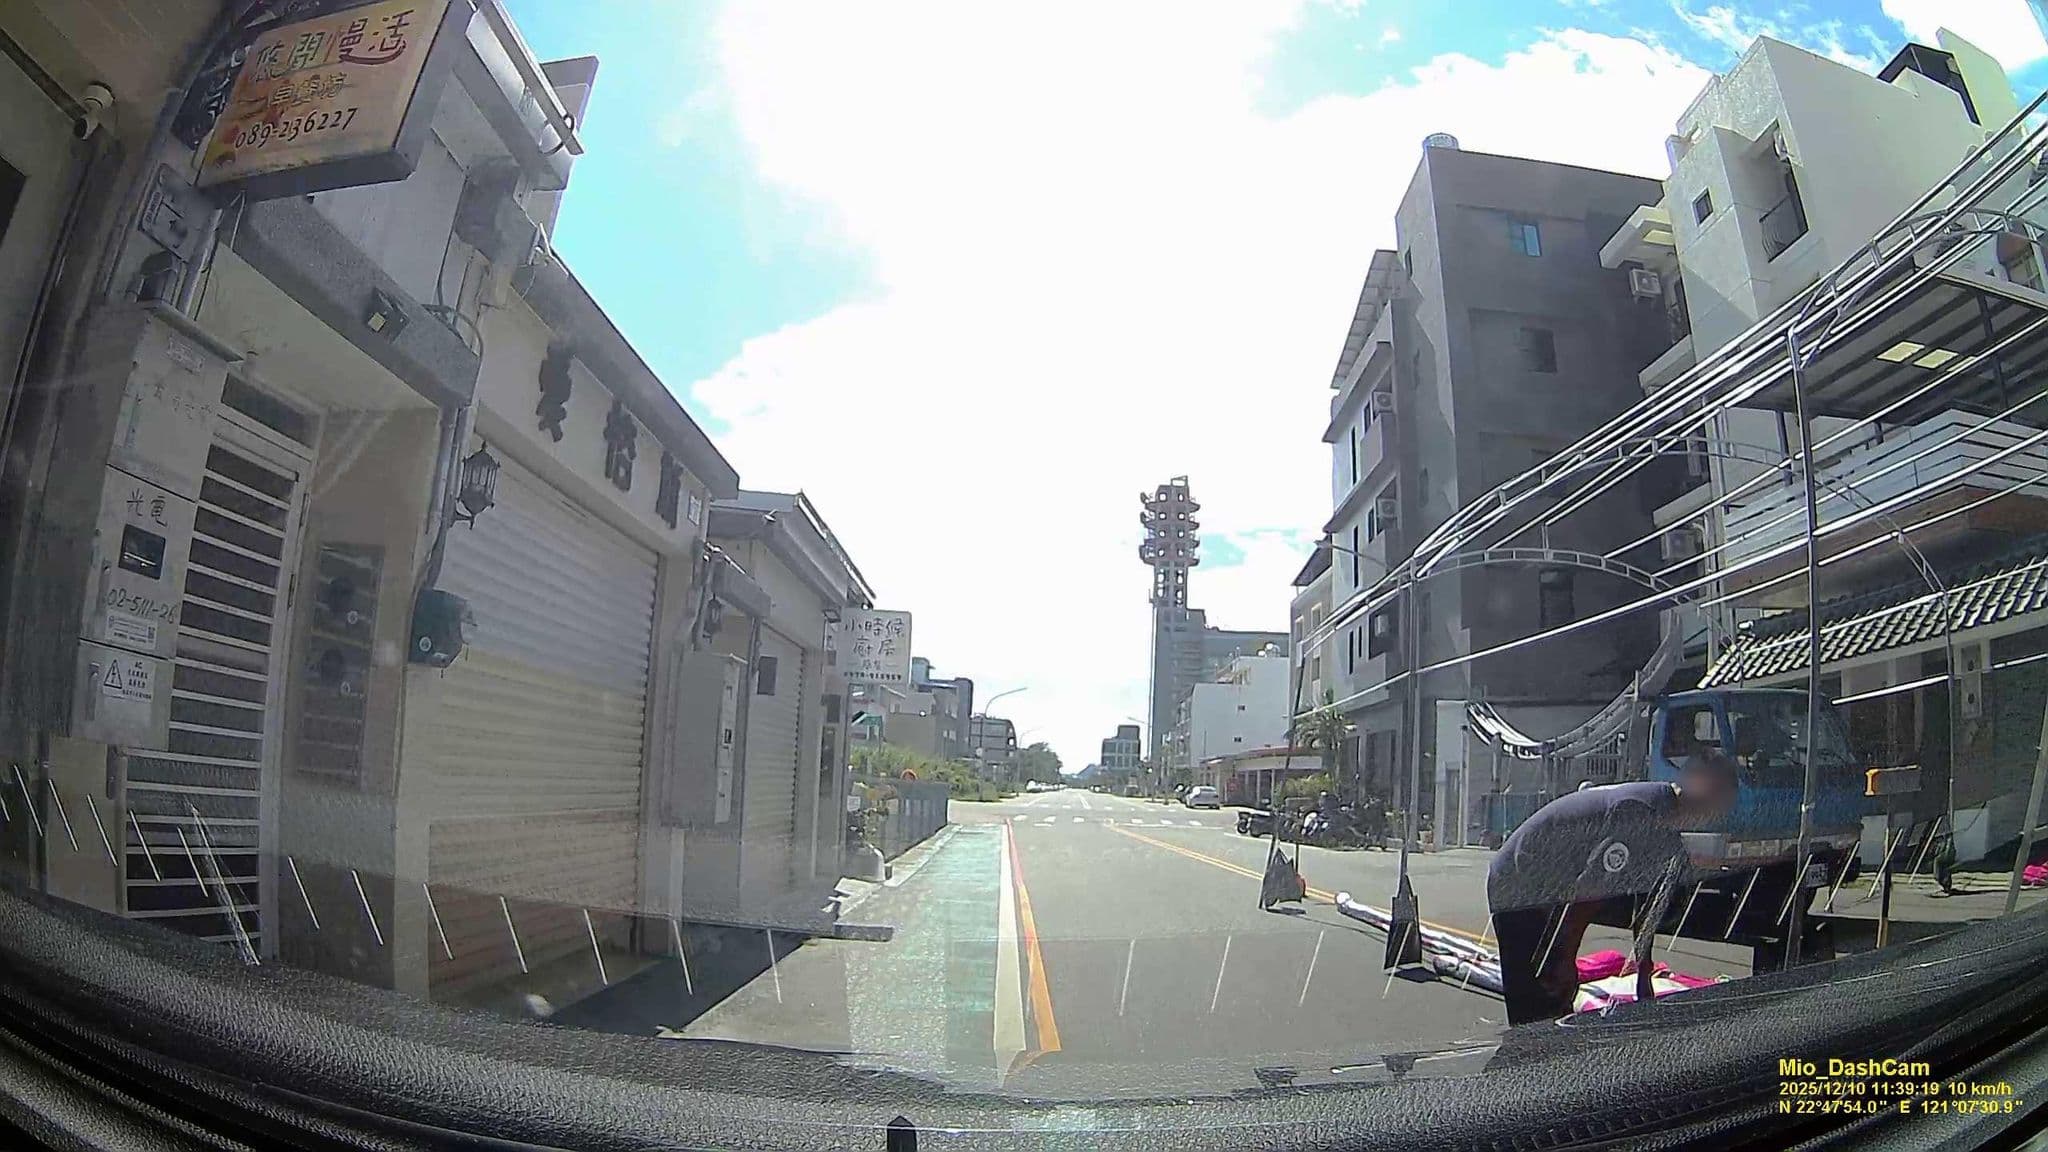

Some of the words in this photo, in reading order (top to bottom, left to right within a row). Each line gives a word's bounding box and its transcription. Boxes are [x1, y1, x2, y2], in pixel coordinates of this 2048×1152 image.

[235, 108, 358, 148] 089-236227
[127, 488, 168, 527] 光電
[845, 617, 904, 637] 小時候
[853, 635, 895, 657] 廚房
